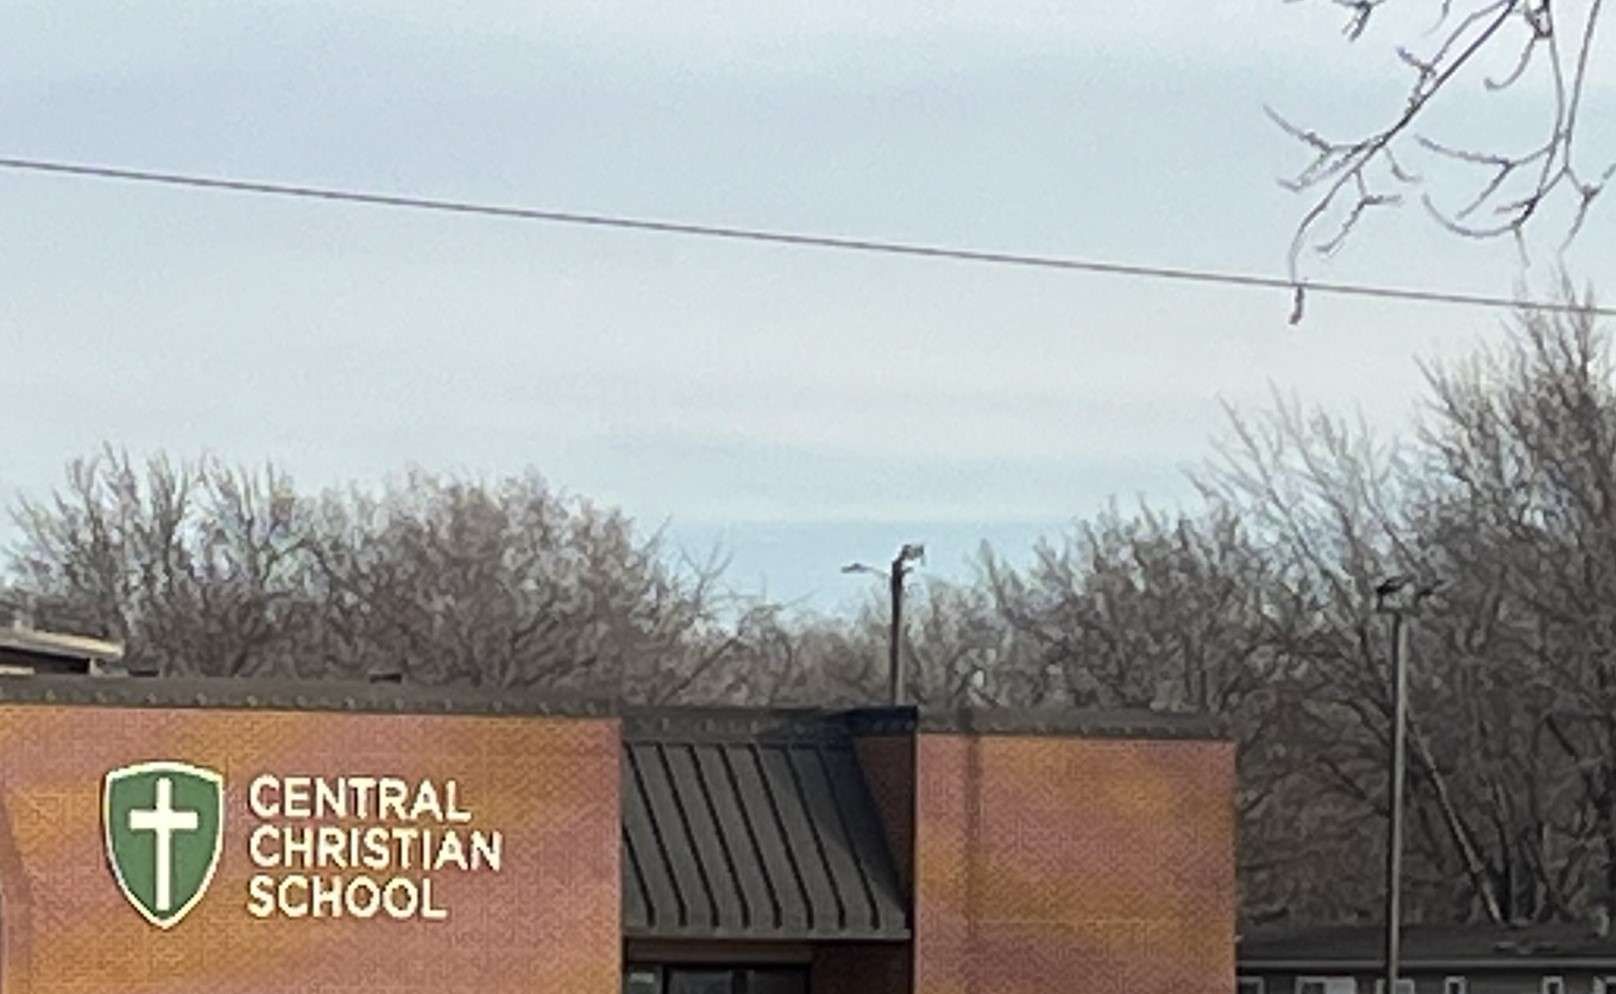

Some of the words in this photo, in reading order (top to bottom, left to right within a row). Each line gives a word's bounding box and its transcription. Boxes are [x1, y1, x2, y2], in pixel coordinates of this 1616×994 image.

[249, 774, 471, 822] CENTRAL
[249, 824, 502, 871] CHRISTIAN
[247, 875, 447, 919] SCHOOL
